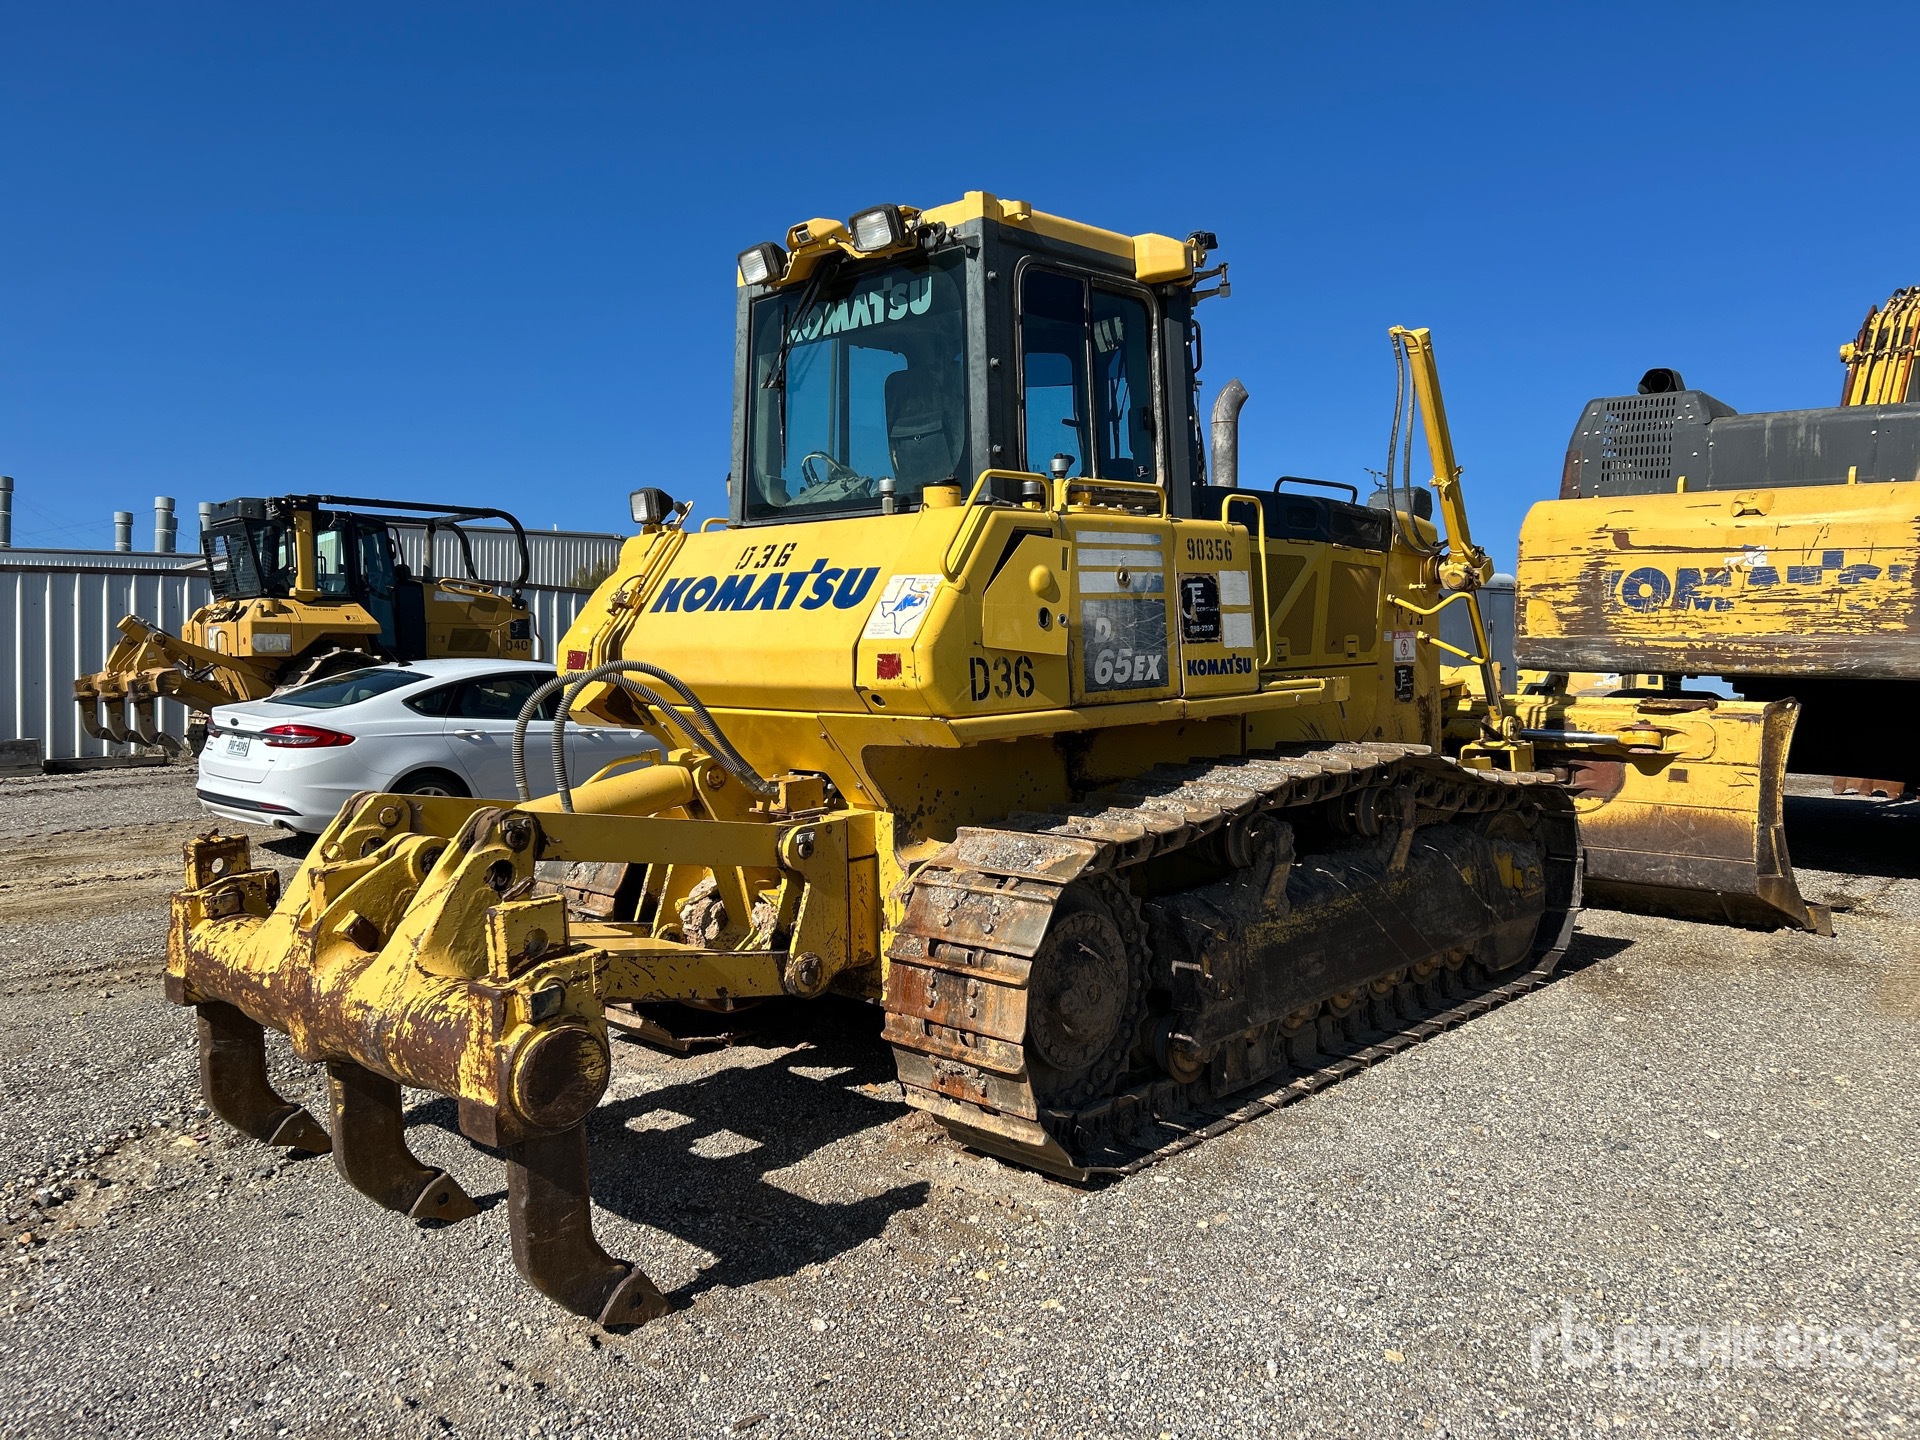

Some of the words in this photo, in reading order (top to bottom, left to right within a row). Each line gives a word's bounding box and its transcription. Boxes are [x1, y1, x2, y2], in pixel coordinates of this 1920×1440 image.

[735, 542, 797, 570] D36
[1186, 537, 1232, 562] 90356
[649, 558, 881, 613] KOMATSU
[969, 655, 1034, 702] D36
[1094, 649, 1163, 685] 65EX
[1187, 653, 1252, 677] KOMATSU
